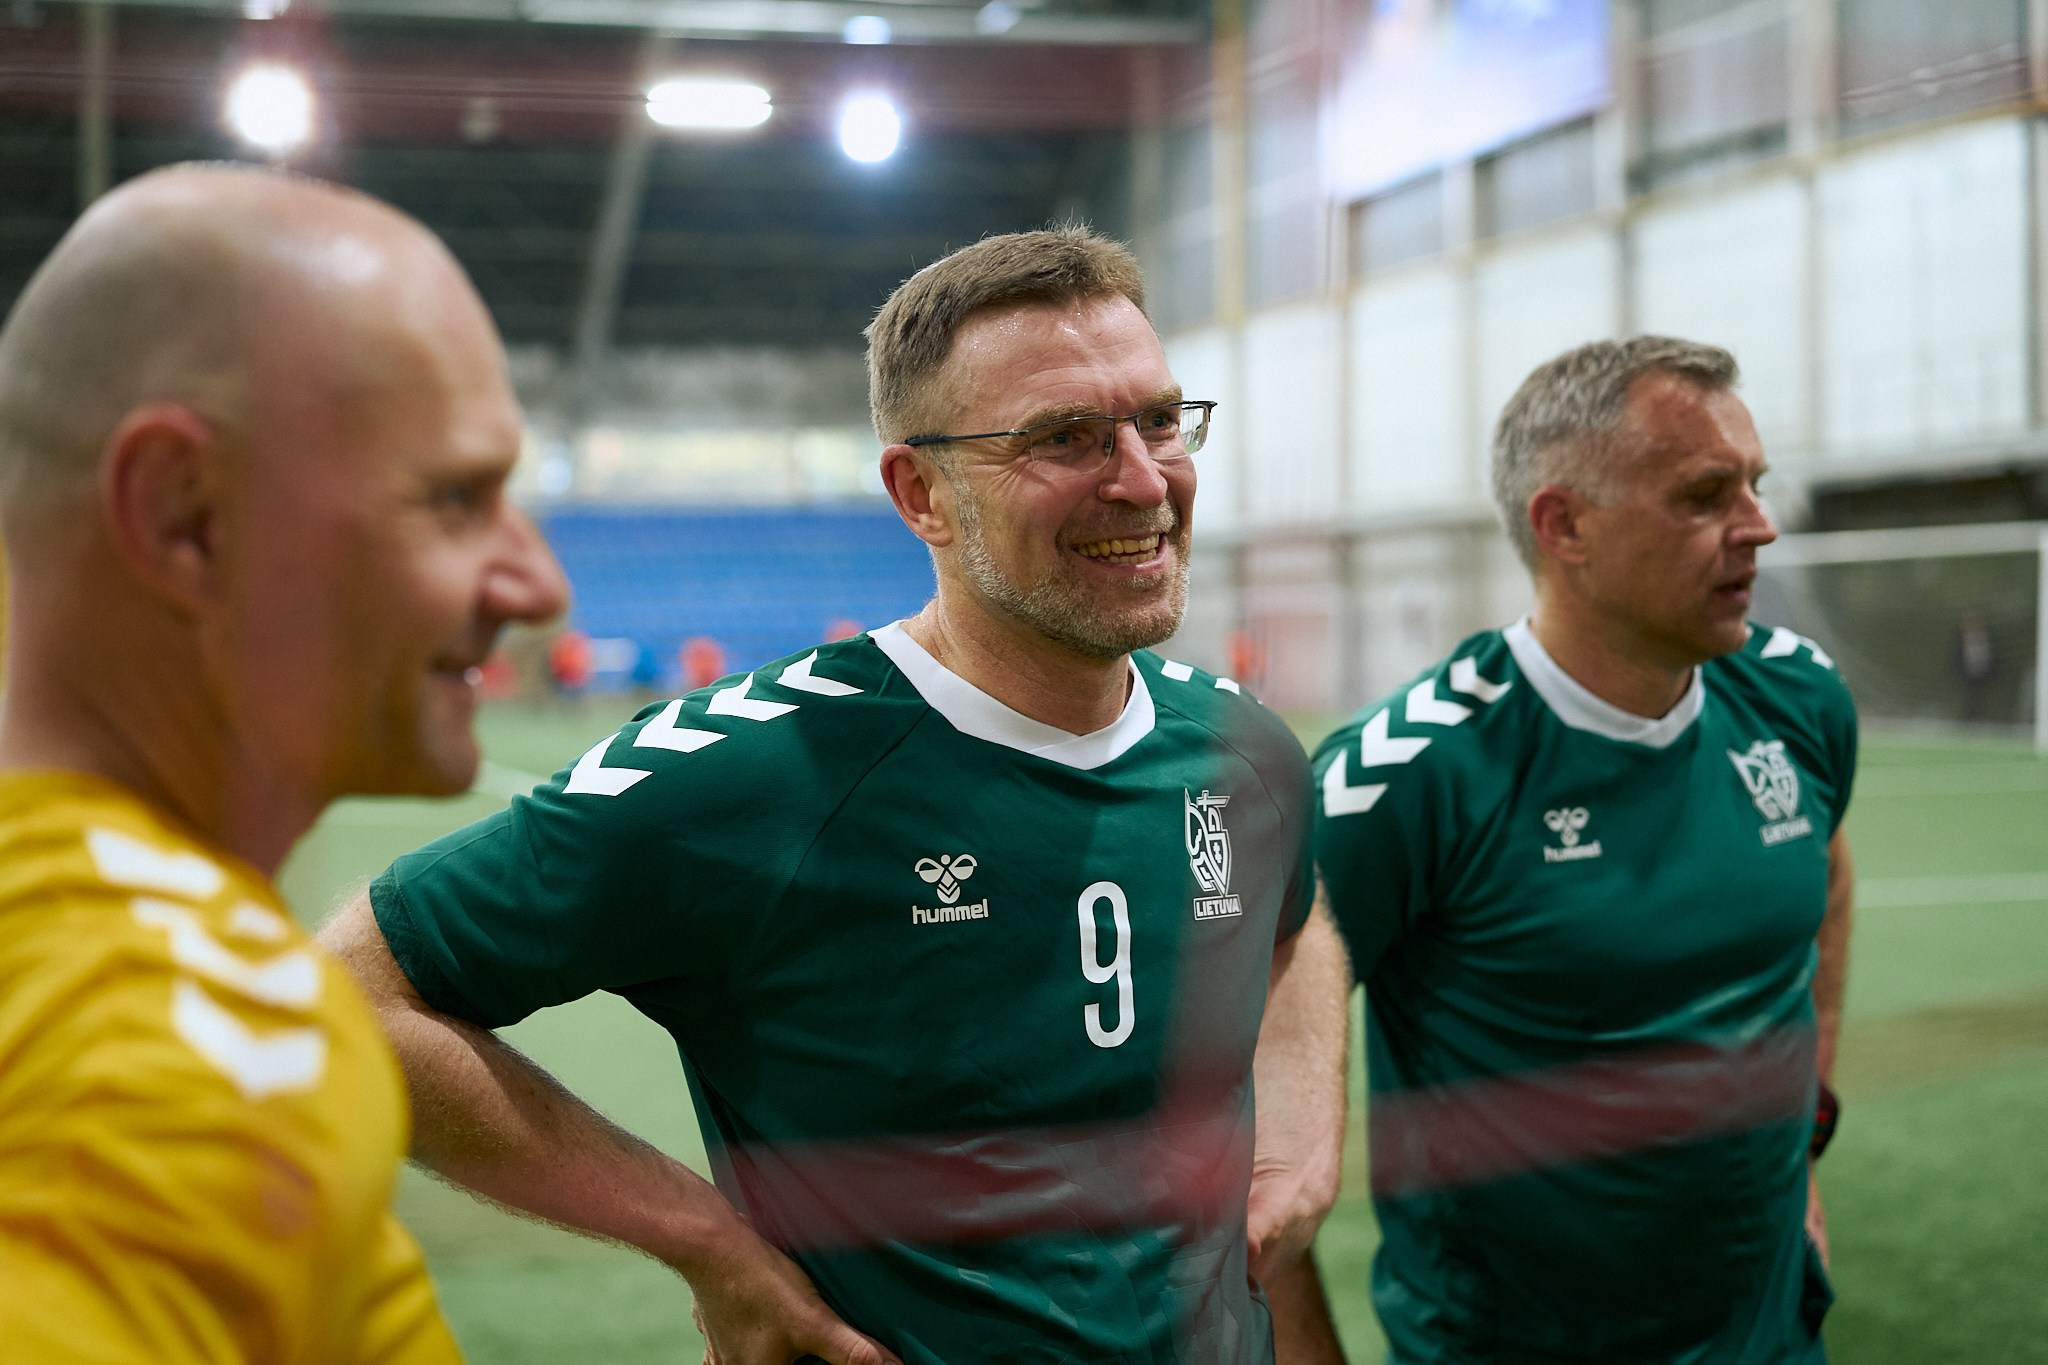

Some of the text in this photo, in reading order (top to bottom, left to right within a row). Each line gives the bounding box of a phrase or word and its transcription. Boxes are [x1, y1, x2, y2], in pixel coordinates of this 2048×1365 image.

[912, 898, 989, 925] hummel
[1196, 897, 1240, 917] LIETUVA
[1078, 881, 1135, 1048] 9
